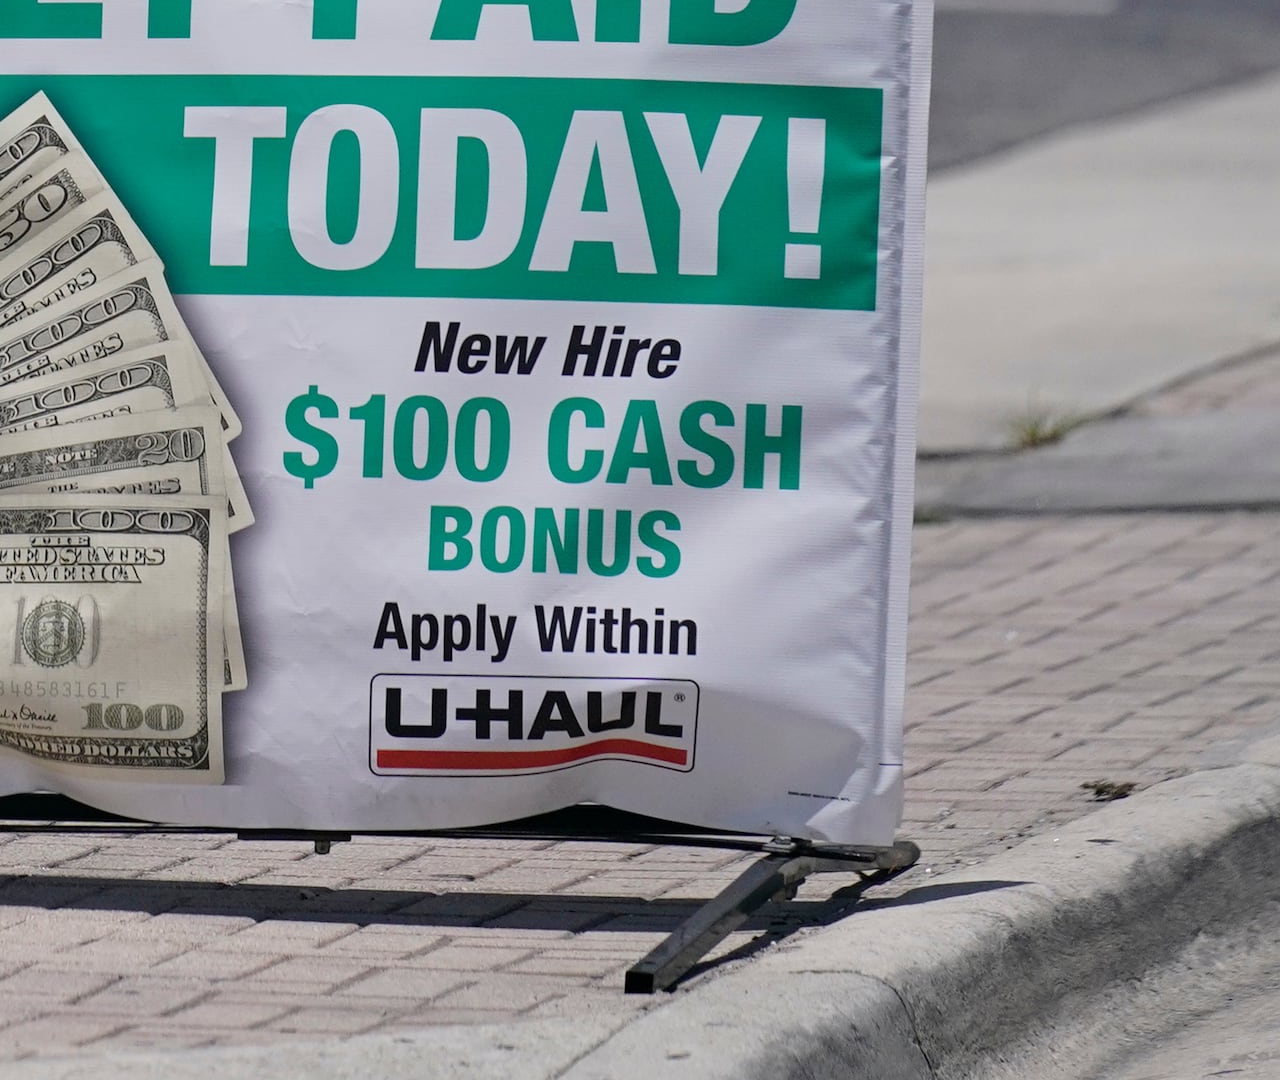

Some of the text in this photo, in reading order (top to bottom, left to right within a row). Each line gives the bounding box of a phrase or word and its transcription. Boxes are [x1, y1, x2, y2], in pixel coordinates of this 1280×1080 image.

[182, 103, 827, 280] TODAY!
[414, 321, 682, 379] New Hire
[6, 363, 154, 423] 100
[45, 448, 99, 468] NOTE
[134, 427, 205, 466] 20
[282, 386, 803, 491] $100 CASH
[44, 509, 193, 531] 100
[427, 505, 682, 578] BONUS
[373, 601, 698, 663] Apply Within
[82, 703, 185, 732] 100
[83, 743, 194, 758] DOLLARS
